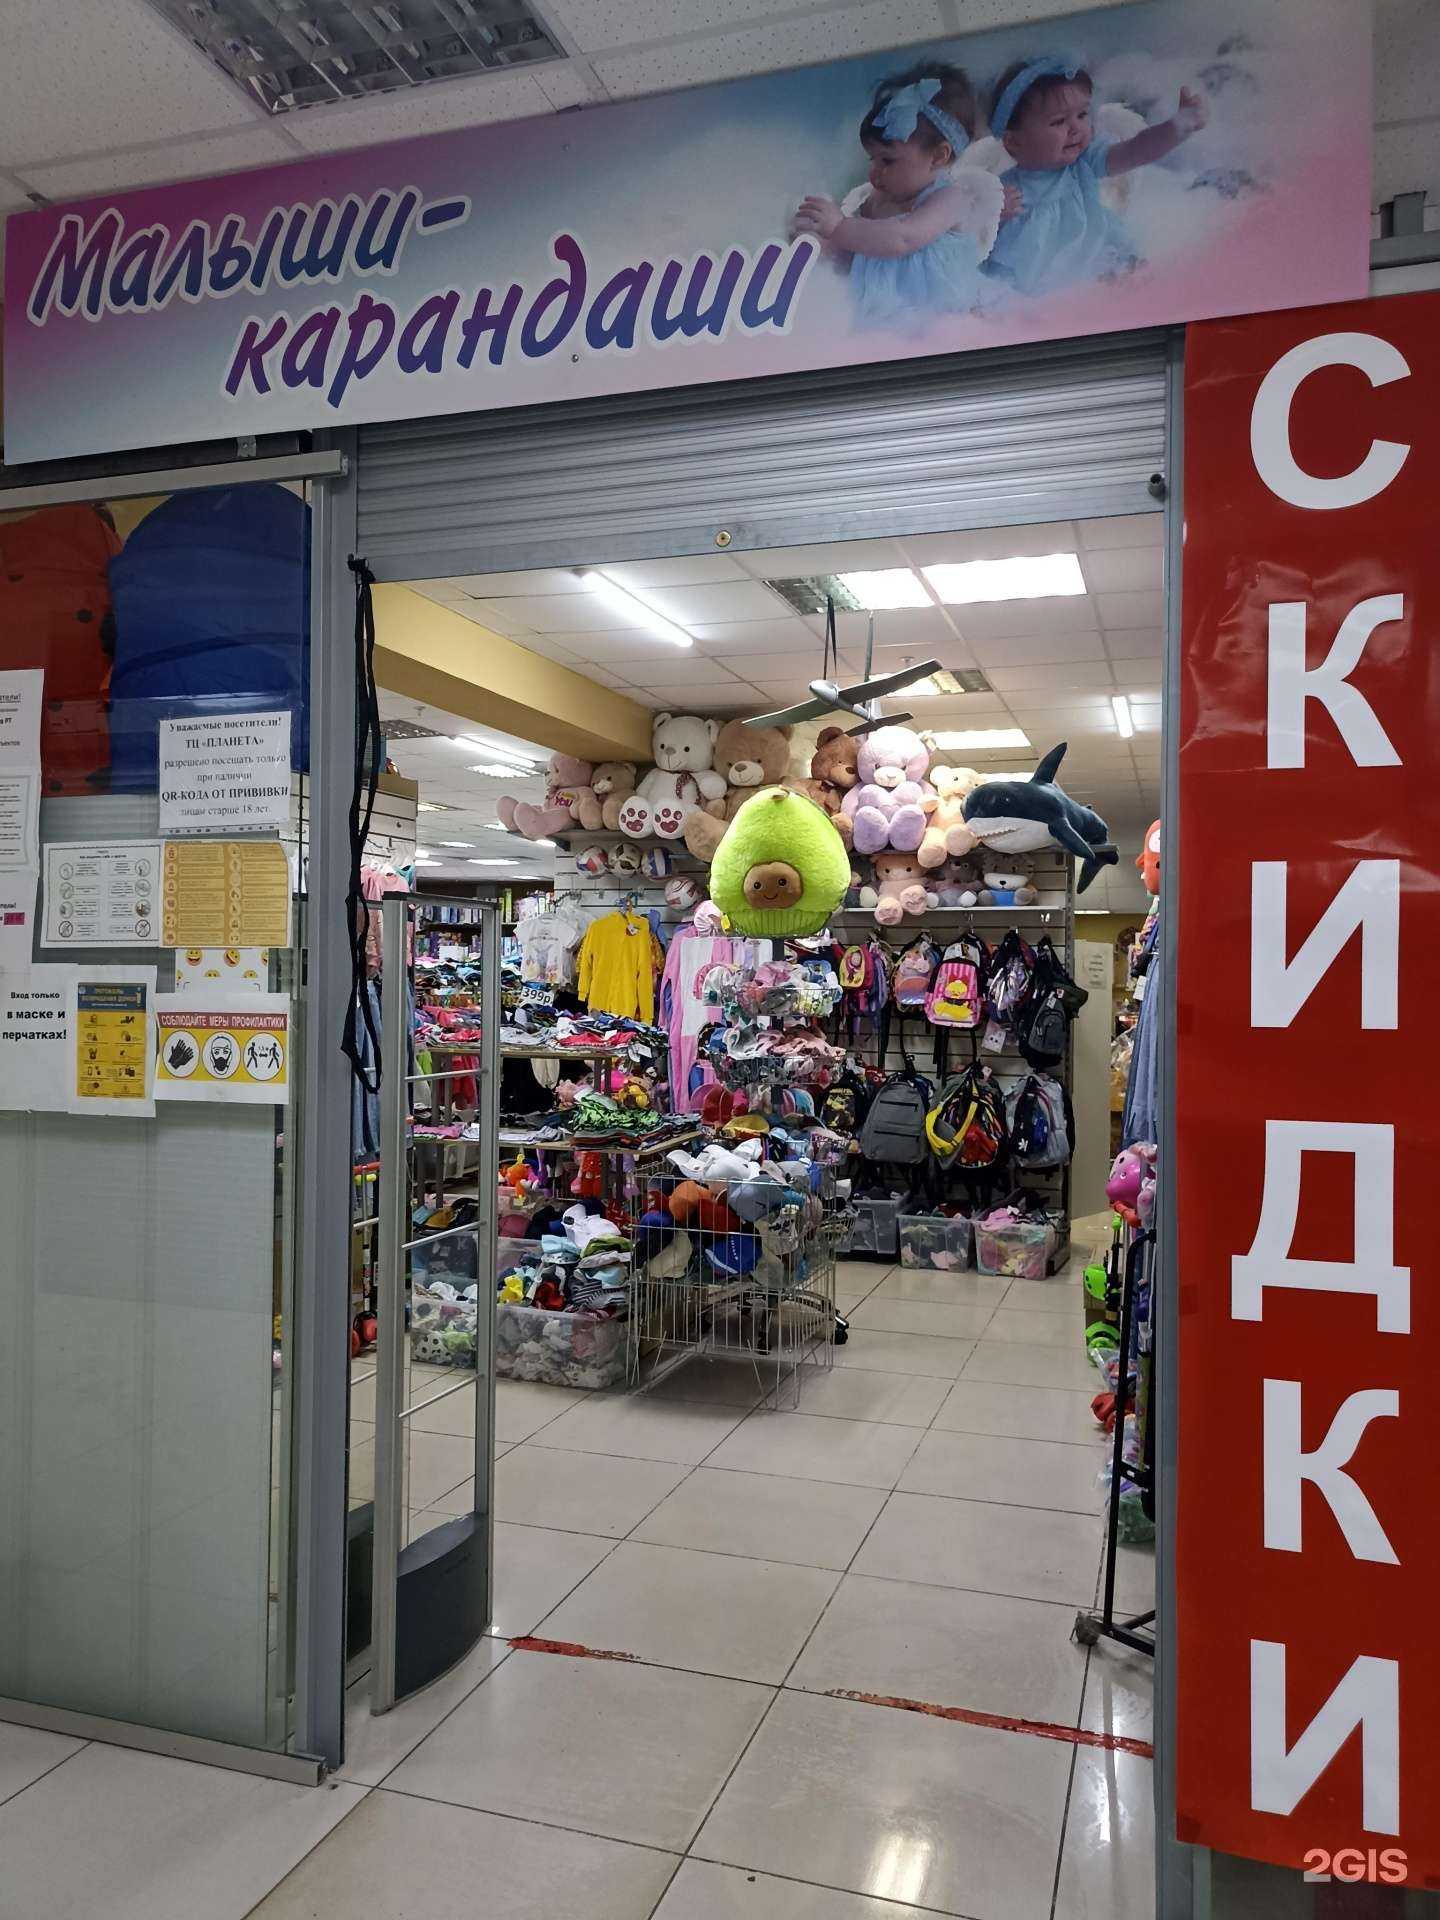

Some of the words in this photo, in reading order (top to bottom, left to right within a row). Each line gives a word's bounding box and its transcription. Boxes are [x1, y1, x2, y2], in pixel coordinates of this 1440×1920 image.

[29, 188, 470, 322] Малыши-
[223, 231, 820, 410] карандаши
[169, 721, 222, 733] Уважаемые
[224, 716, 282, 729] посетители!
[185, 738, 200, 750] ТЦ
[202, 735, 265, 748] «ПЛАНЕТА»
[164, 758, 210, 770] разрешено
[212, 756, 254, 767] посещать
[256, 754, 287, 764] только
[162, 790, 210, 803] QR-КОДА
[211, 789, 227, 799] ОТ
[229, 786, 289, 799] ПРИВИВКИ
[208, 804, 240, 817] старше
[242, 804, 253, 814] 18
[10, 991, 30, 999] Вход
[7, 1011, 13, 1019] в
[16, 1010, 54, 1019] маске
[57, 1010, 66, 1019] и
[161, 1014, 207, 1026] СОБЛЮДАЙТЕ
[209, 1016, 229, 1026] МЕРЫ
[231, 1016, 285, 1028] ПРОФИЛАКТИКИ
[2, 1029, 67, 1042] перчатках!
[1229, 331, 1412, 1838] СКИДКИ
